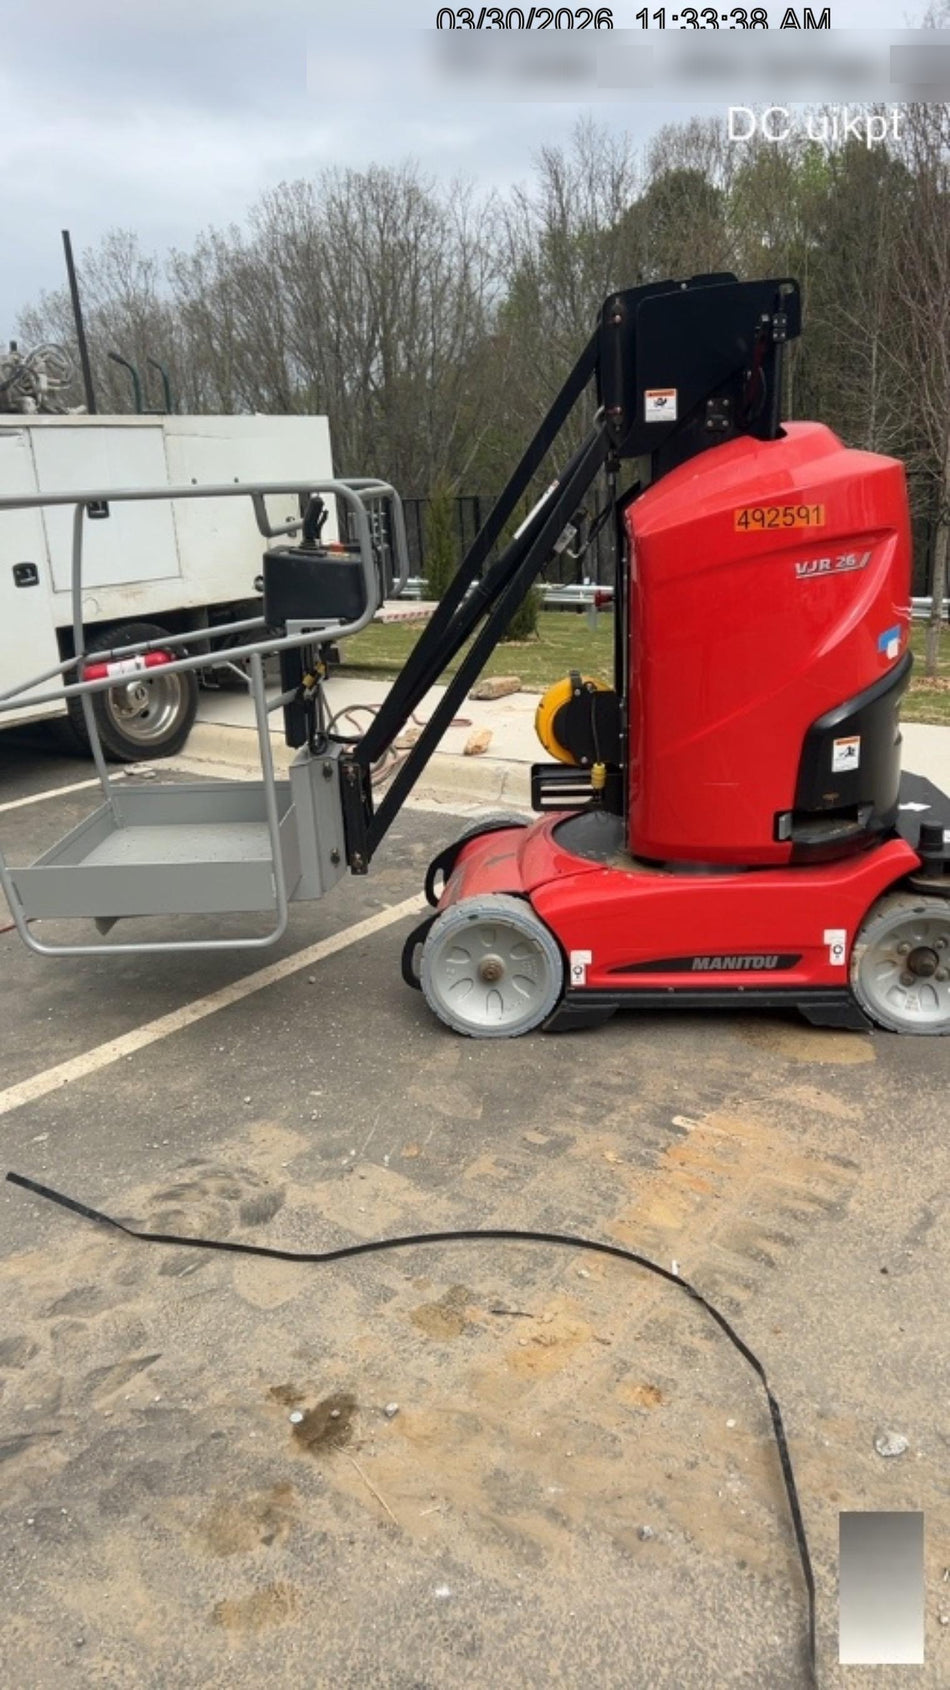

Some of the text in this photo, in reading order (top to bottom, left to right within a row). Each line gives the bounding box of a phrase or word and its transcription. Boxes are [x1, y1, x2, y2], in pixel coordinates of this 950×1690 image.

[737, 505, 821, 530] 492591
[795, 553, 856, 574] VJR 26
[692, 956, 779, 970] MANITOU
